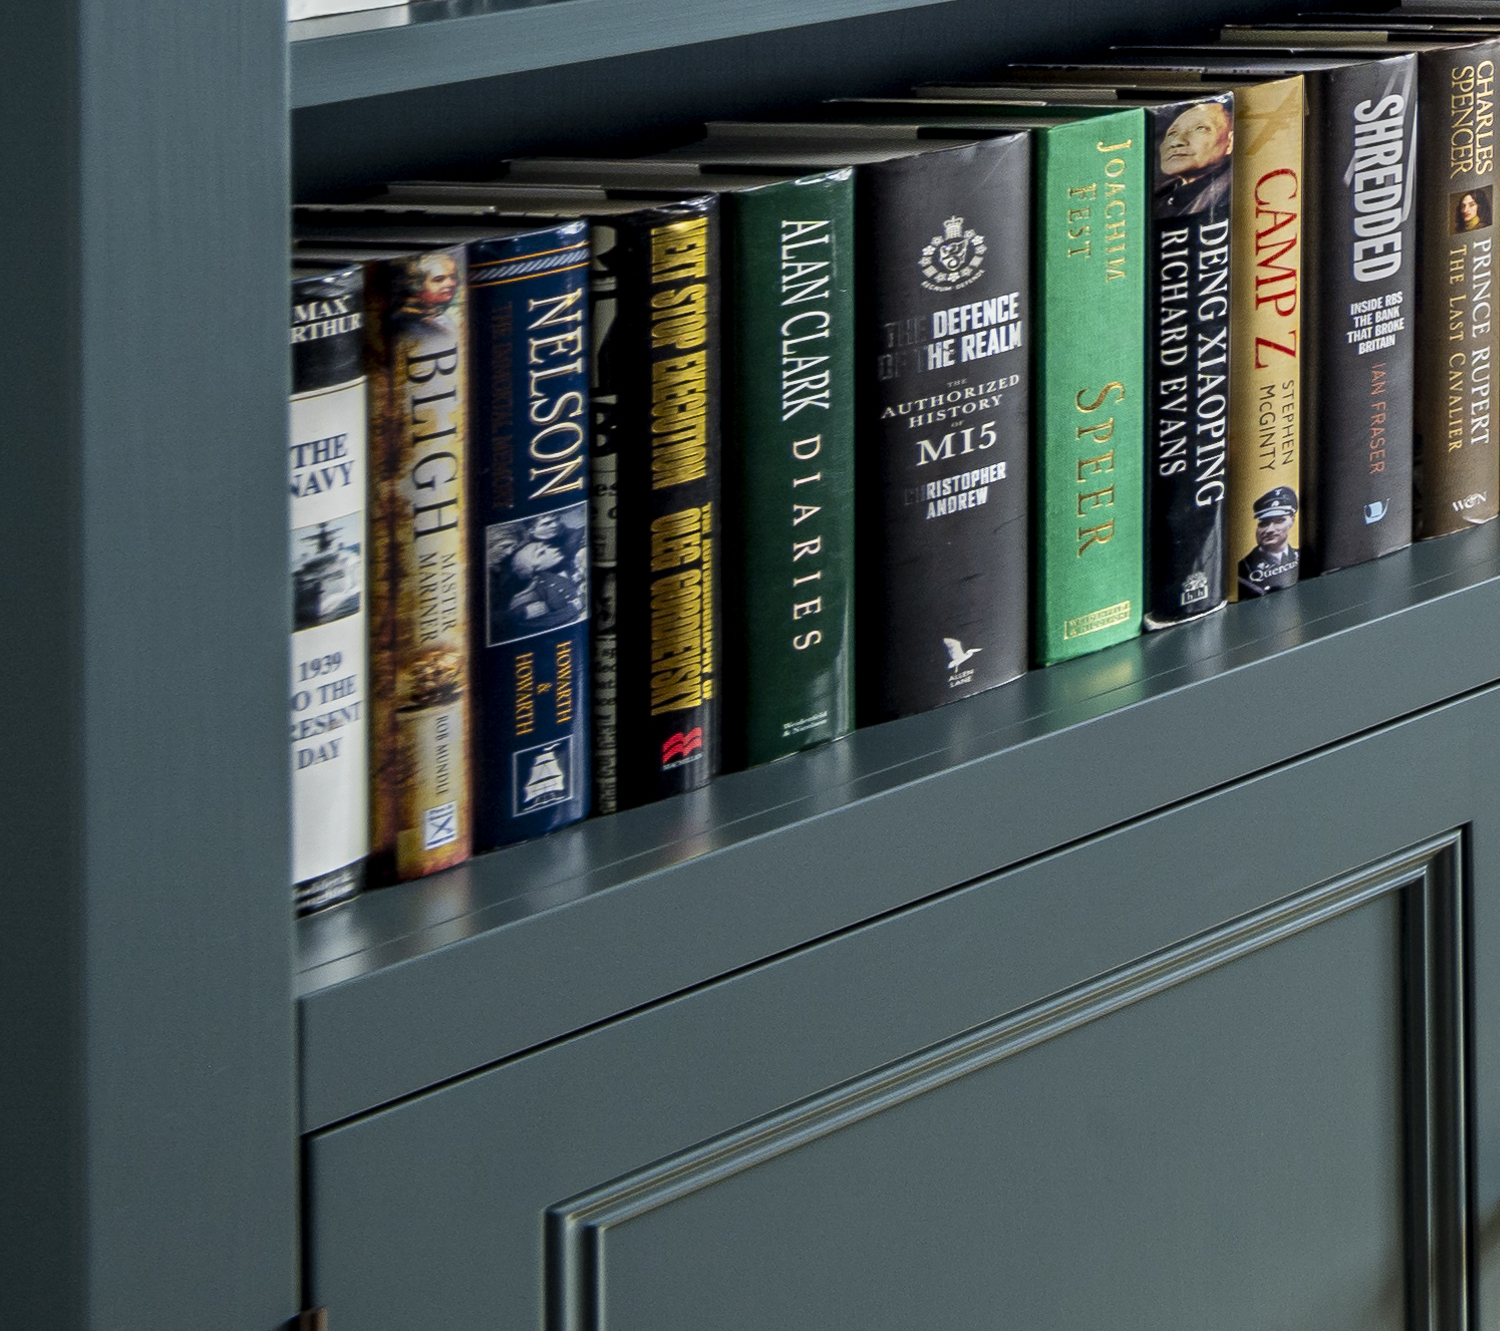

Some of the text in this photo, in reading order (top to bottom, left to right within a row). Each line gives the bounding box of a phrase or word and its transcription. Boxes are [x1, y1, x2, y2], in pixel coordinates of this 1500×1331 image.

[1067, 185, 1096, 260] FEST
[1099, 141, 1132, 282] JOACHIM
[1255, 167, 1297, 369] CAMP Z
[1353, 96, 1403, 282] SHREDDED
[527, 291, 582, 500] NELSON
[781, 219, 830, 421] ALAN CLARK
[1158, 229, 1189, 477] RICHARD EVANS
[1196, 223, 1228, 506] DENG XIAOPING
[406, 350, 456, 538] BLIGH
[1075, 381, 1124, 556] SPEER
[1281, 380, 1295, 466] STEPHEN
[1369, 363, 1386, 474] IAN FRASER
[417, 552, 437, 643] MARINER
[439, 554, 456, 632] MASTER
[792, 434, 822, 651] DIARIES
